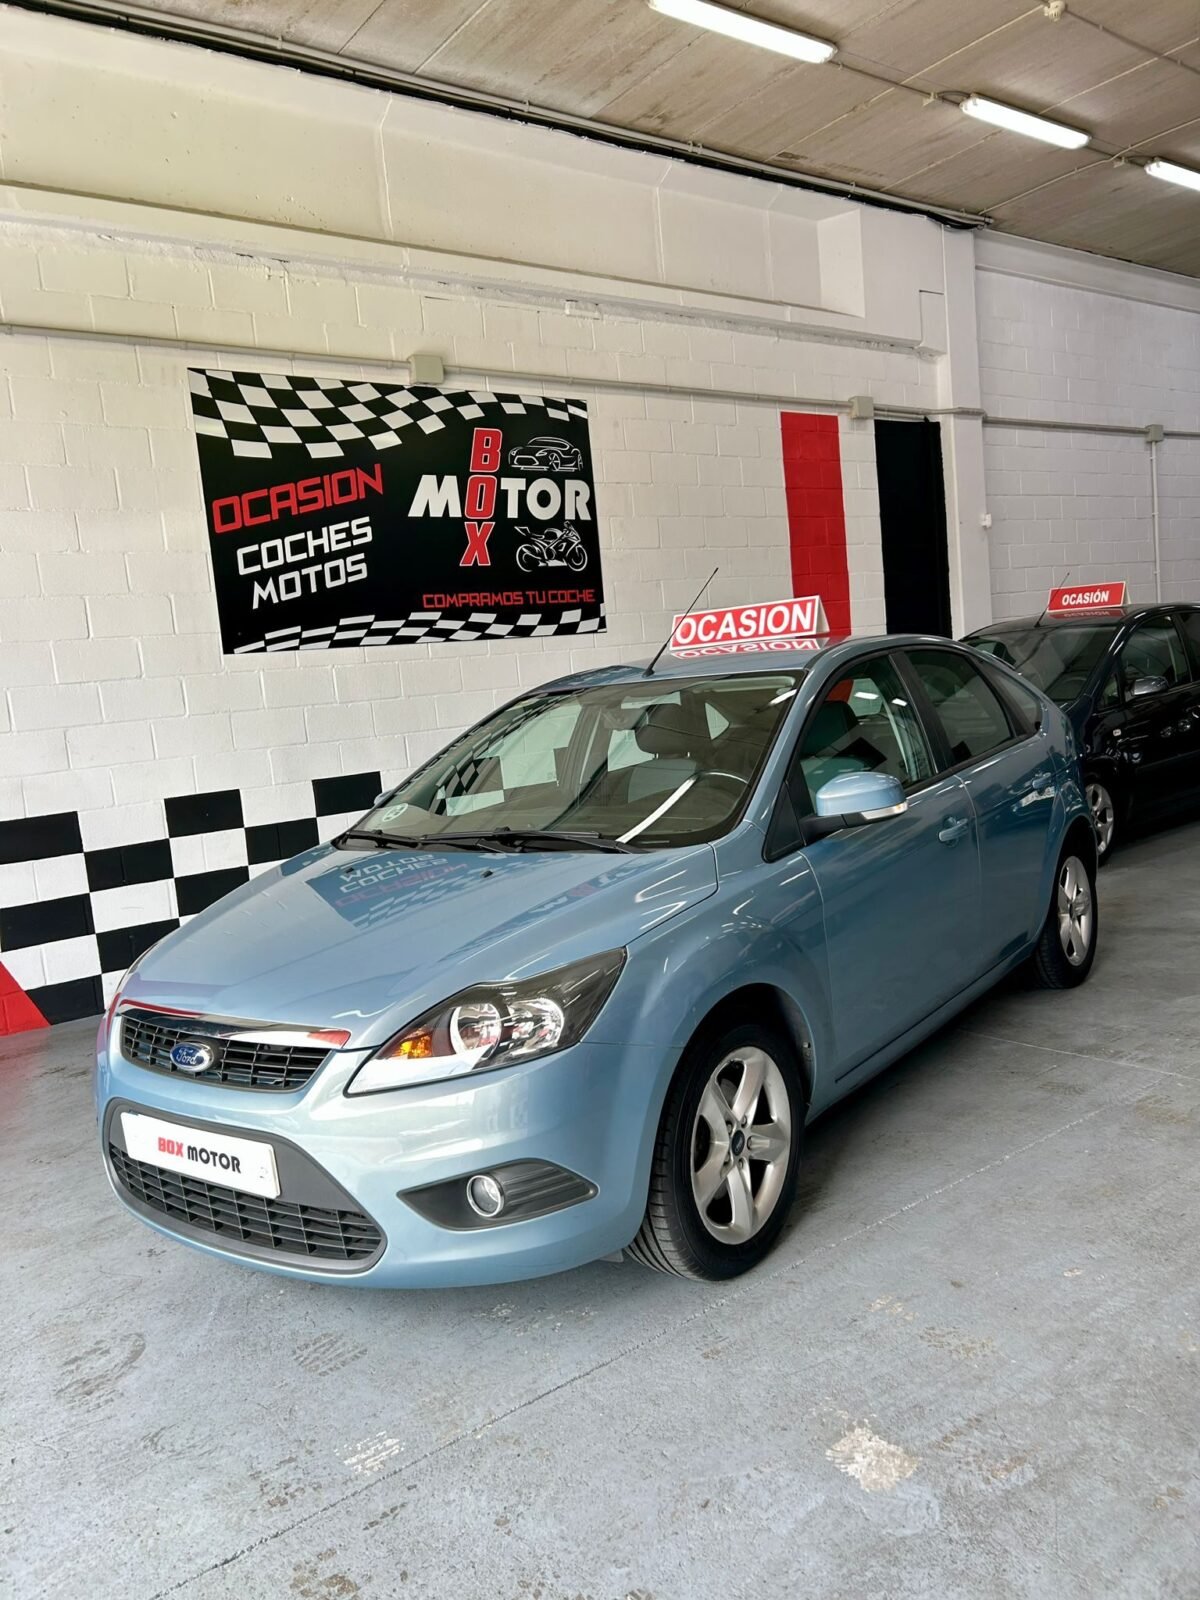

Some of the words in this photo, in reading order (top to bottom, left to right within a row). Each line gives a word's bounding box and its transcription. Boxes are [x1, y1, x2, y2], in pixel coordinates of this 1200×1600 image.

[211, 463, 384, 534] OCASION
[407, 474, 592, 521] MOTOR
[459, 427, 503, 567] BOX
[236, 516, 373, 576] COCHES
[252, 552, 368, 609] MOTOS
[422, 591, 524, 609] COMPRAMOS
[525, 590, 546, 605] TU
[547, 588, 596, 604] COCHE
[1061, 589, 1110, 606] OCASIÓN
[674, 601, 813, 645] OCASION
[175, 1049, 199, 1065] Ford
[157, 1136, 185, 1158] BOX
[186, 1145, 242, 1174] MOTOR
